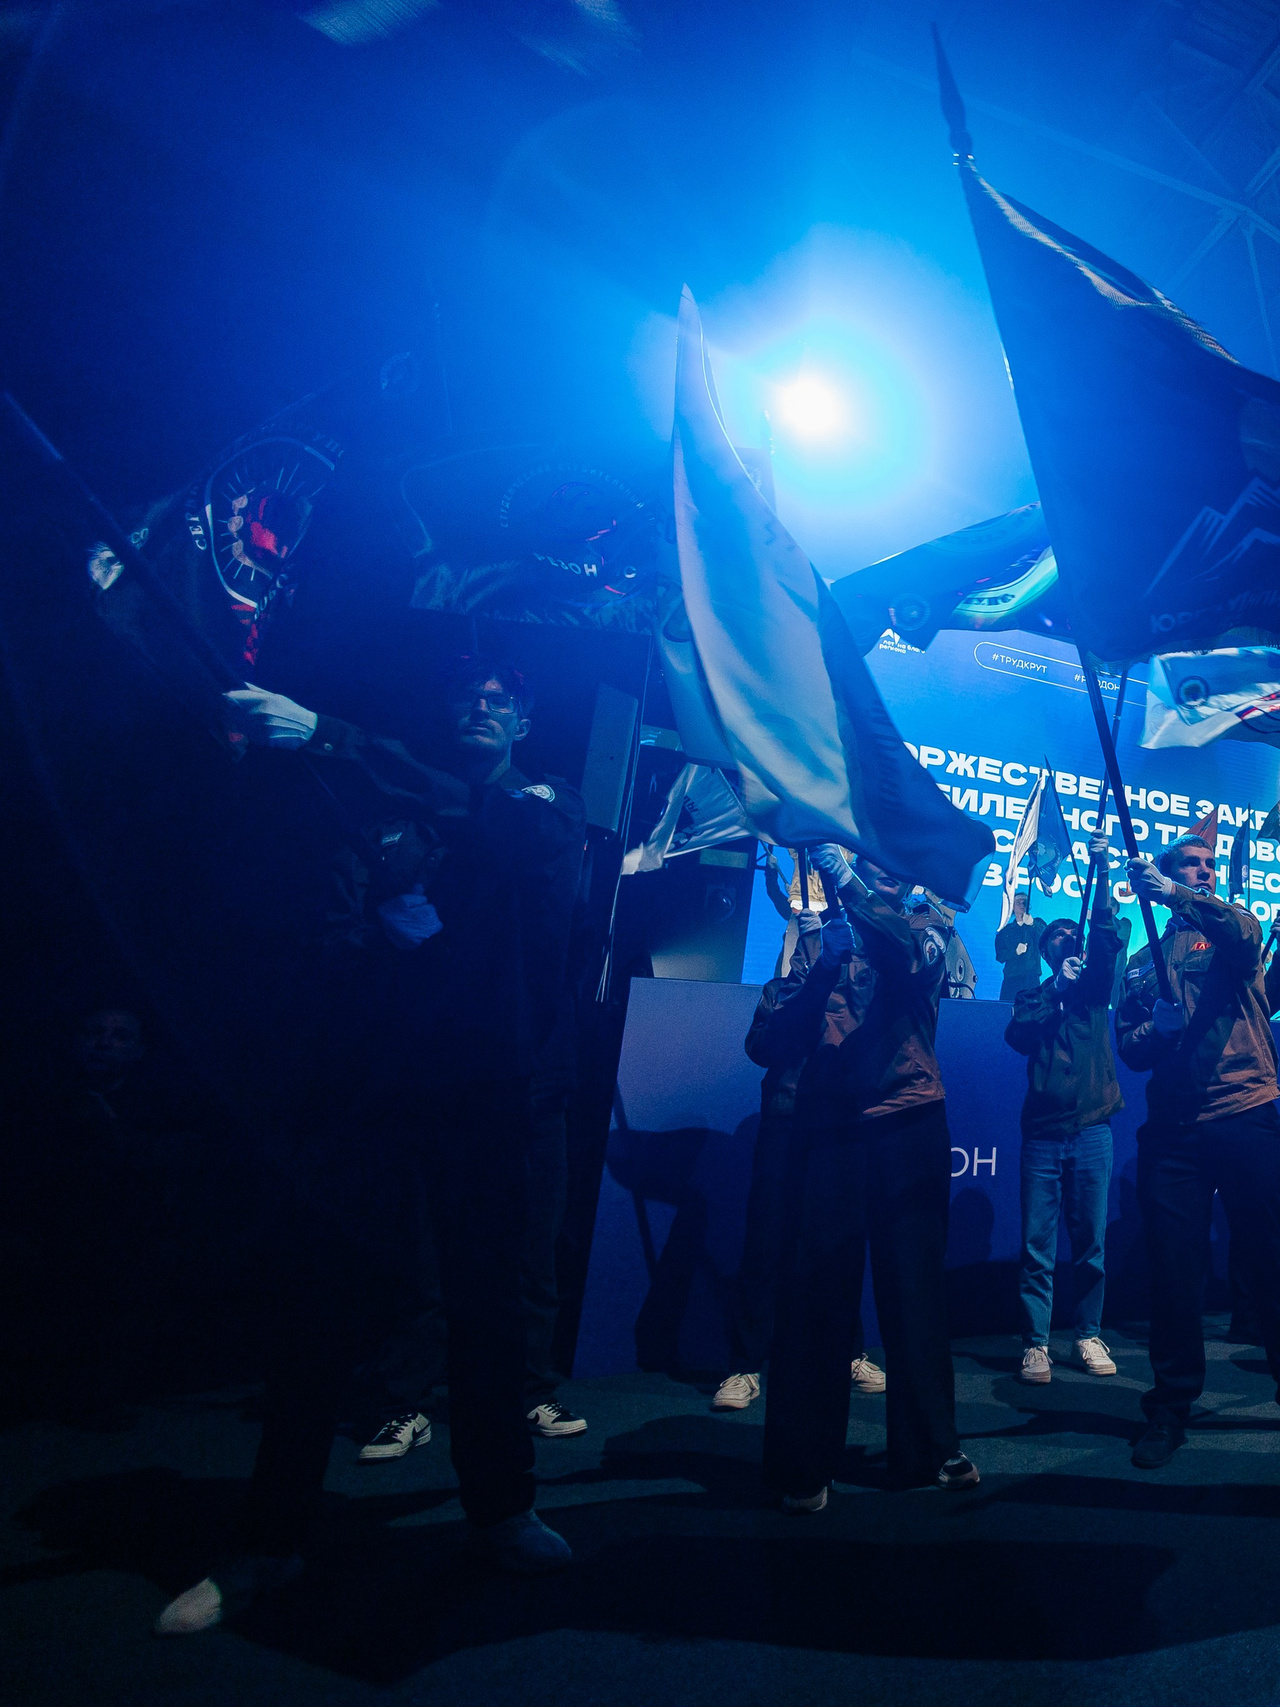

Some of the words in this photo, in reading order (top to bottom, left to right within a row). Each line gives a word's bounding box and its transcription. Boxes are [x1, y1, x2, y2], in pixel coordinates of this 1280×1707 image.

[992, 652, 1047, 674] #ТРУДКРУТ
[1074, 673, 1121, 691] #РДОН
[950, 1146, 997, 1177] ОН
